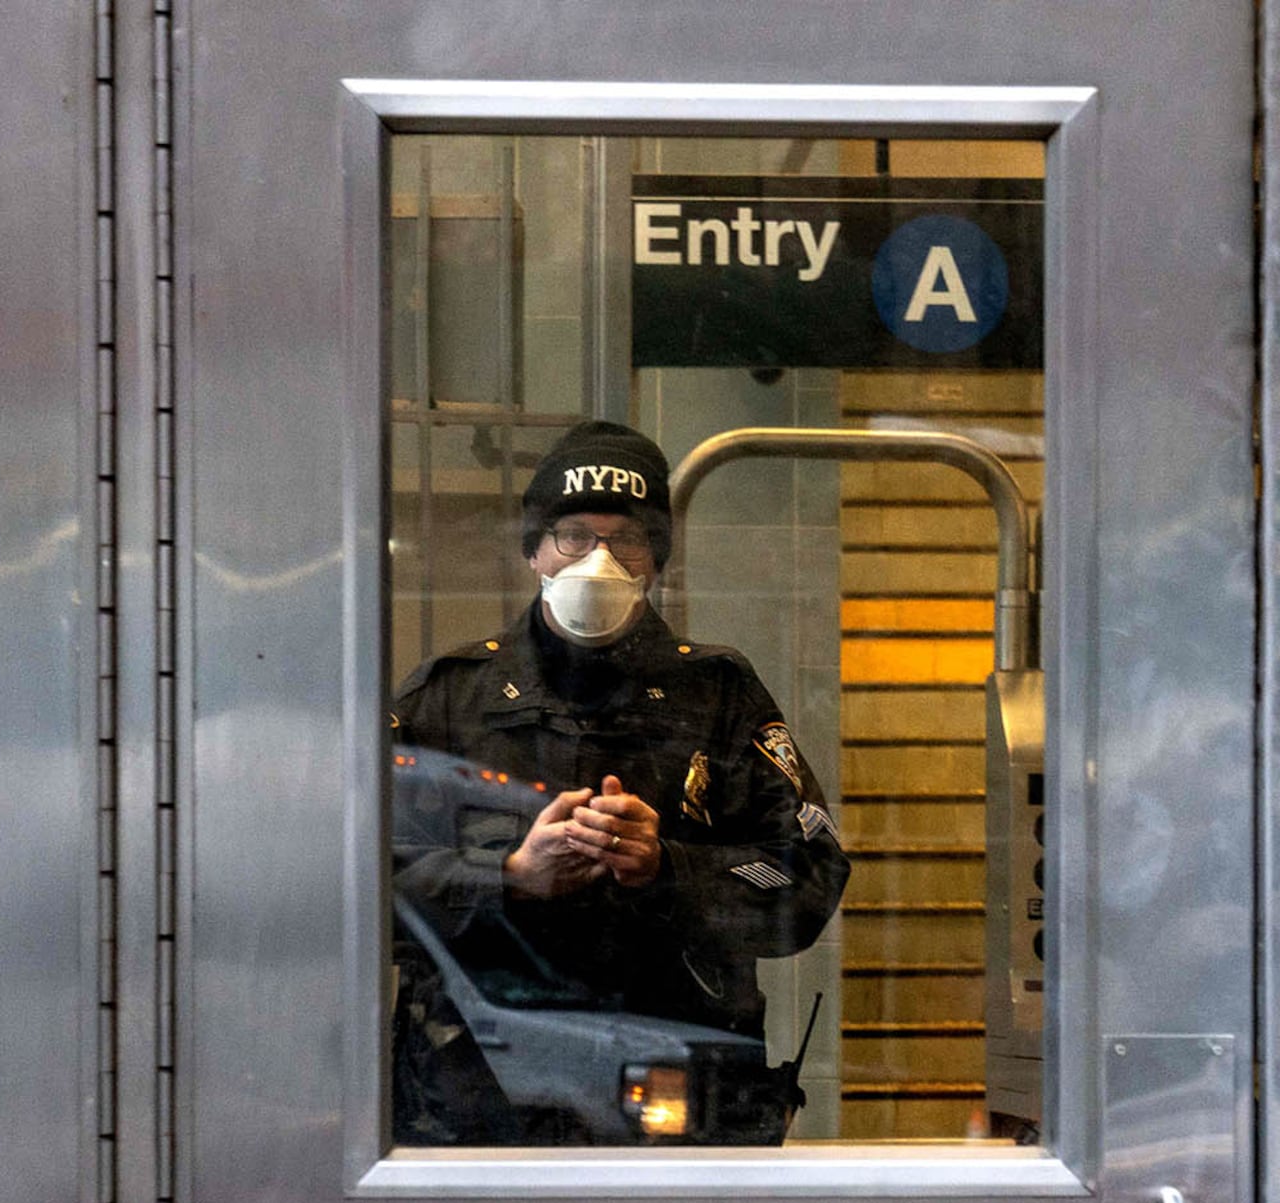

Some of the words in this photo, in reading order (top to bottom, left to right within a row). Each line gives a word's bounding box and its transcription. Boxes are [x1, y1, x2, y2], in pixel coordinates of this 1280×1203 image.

[634, 203, 841, 281] Entry
[904, 246, 978, 323] A
[562, 465, 647, 499] NYPD
